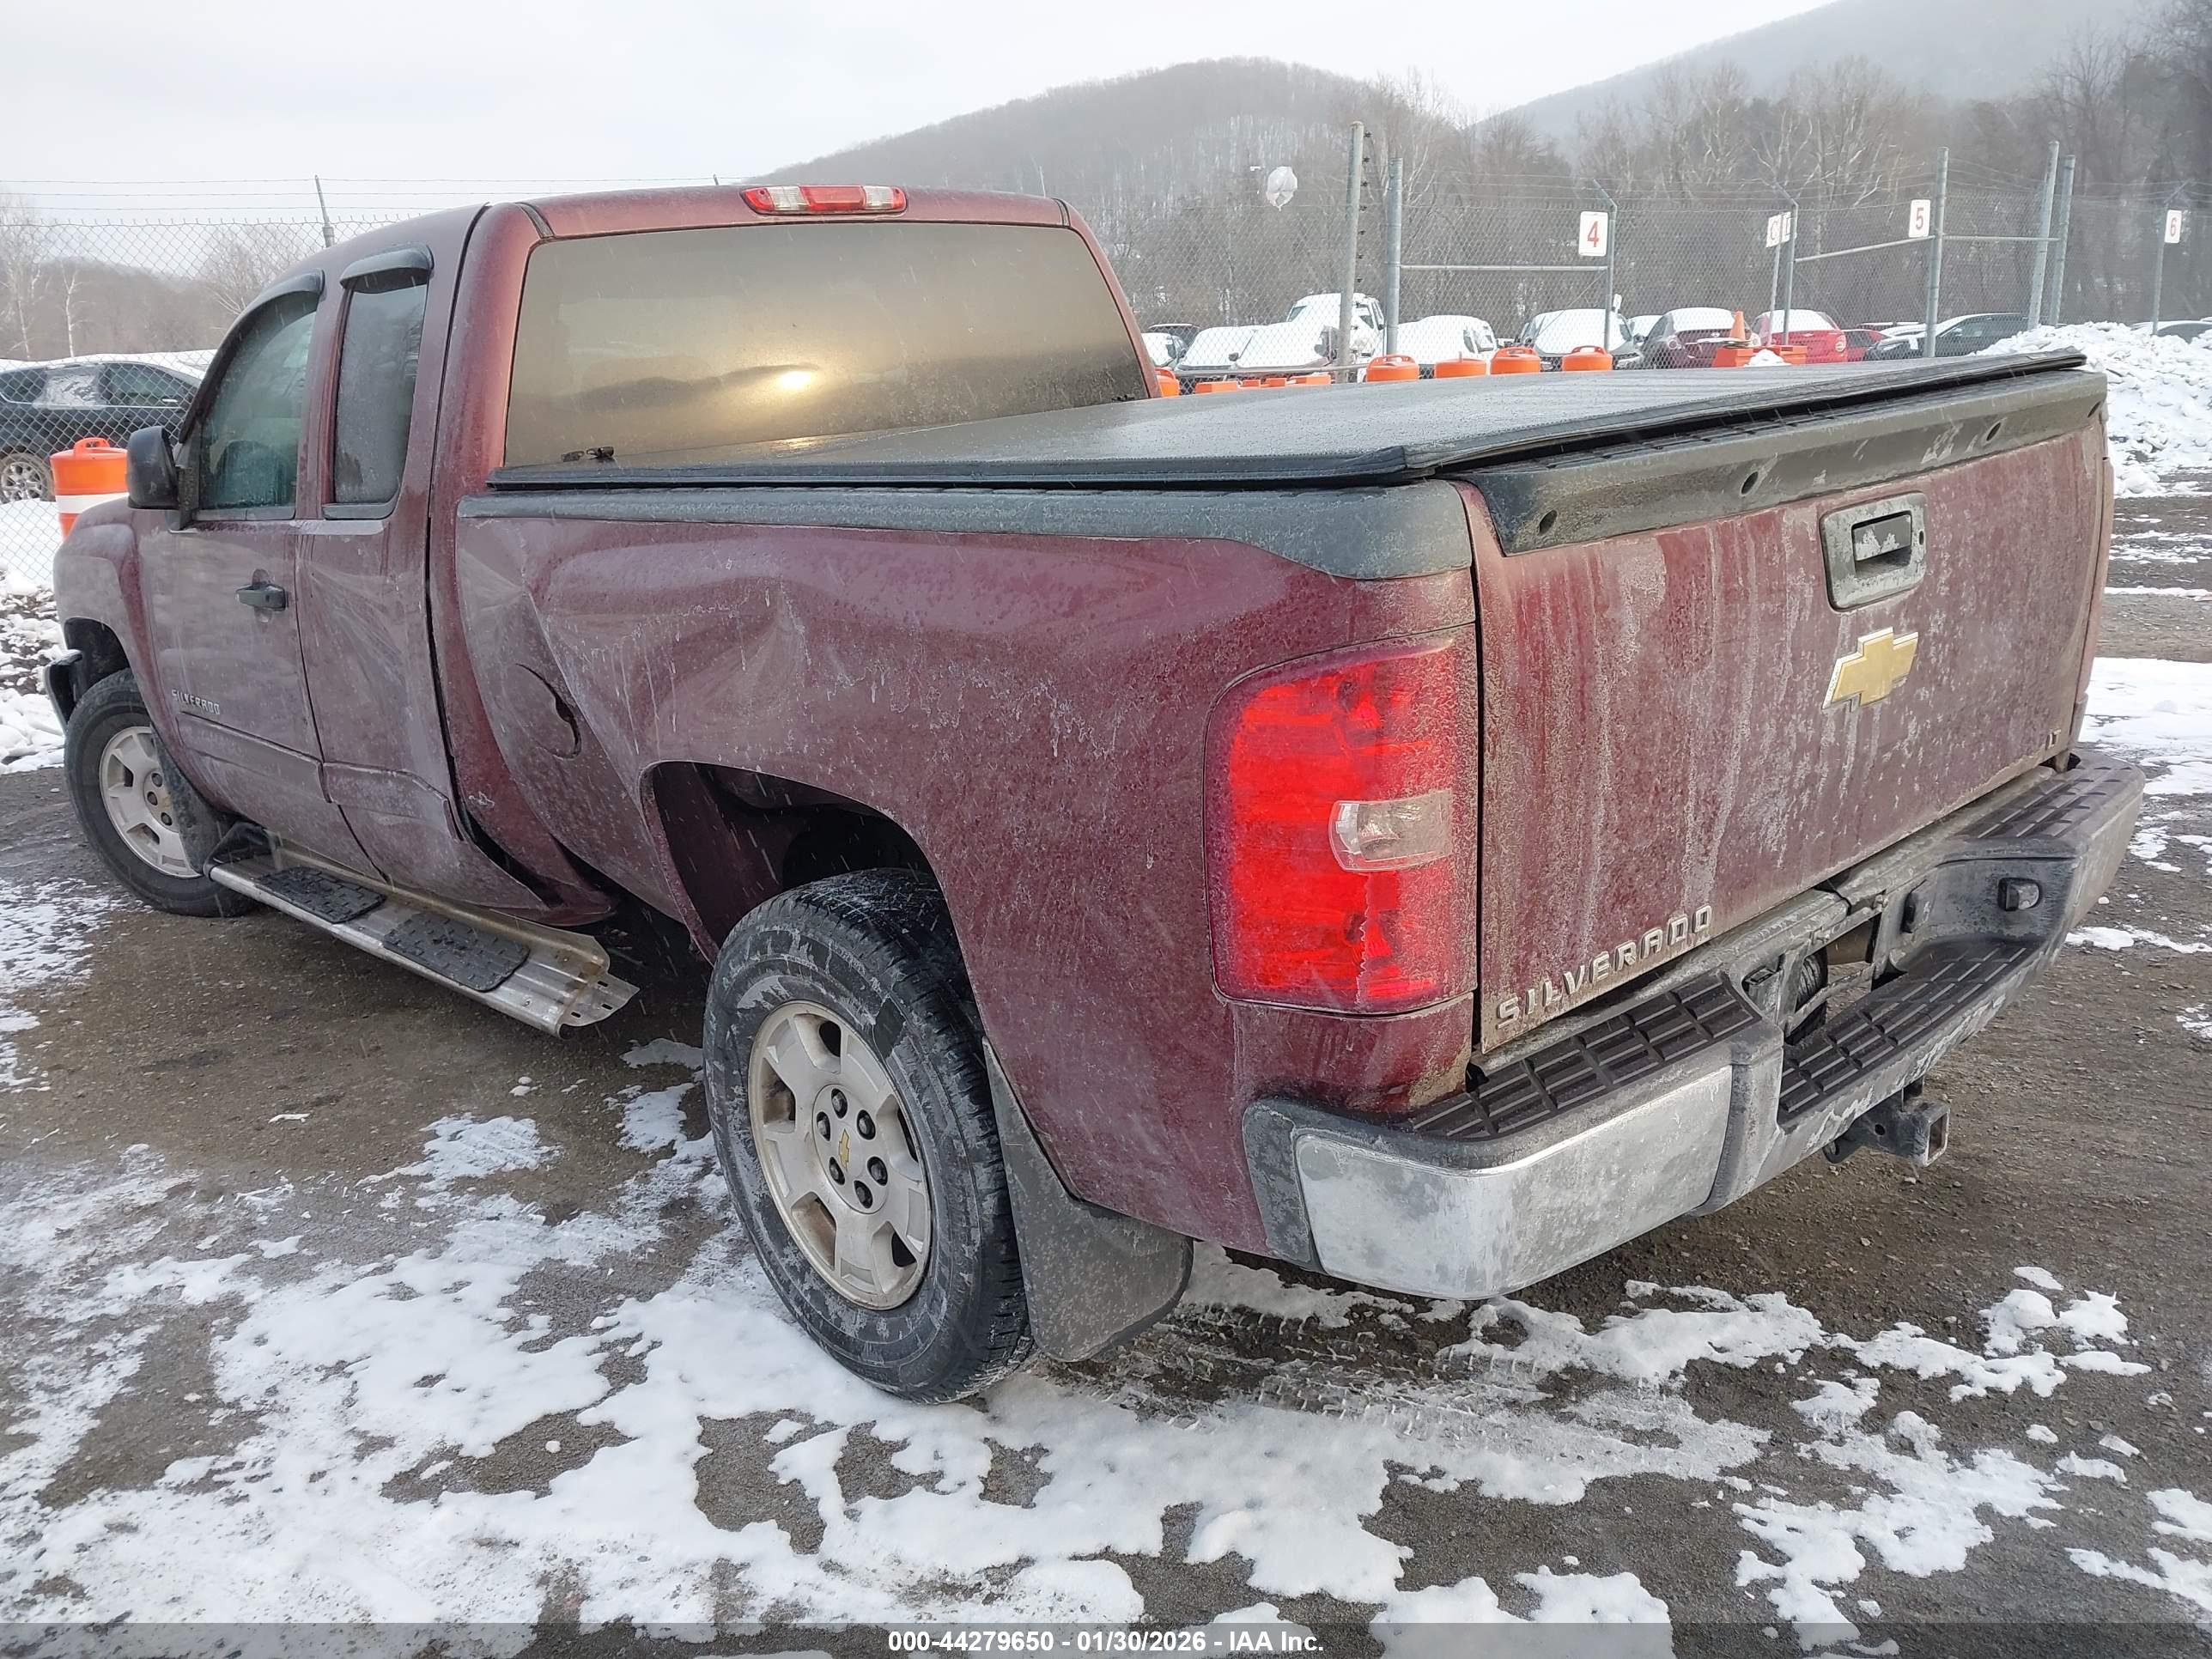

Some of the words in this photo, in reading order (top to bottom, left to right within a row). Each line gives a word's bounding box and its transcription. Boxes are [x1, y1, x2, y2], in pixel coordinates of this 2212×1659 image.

[1916, 207, 1924, 230] 5
[2171, 217, 2177, 237] 6
[1587, 221, 1600, 247] 4
[172, 690, 220, 714] SILVERADO
[1496, 904, 1712, 1030] SILVERADO
